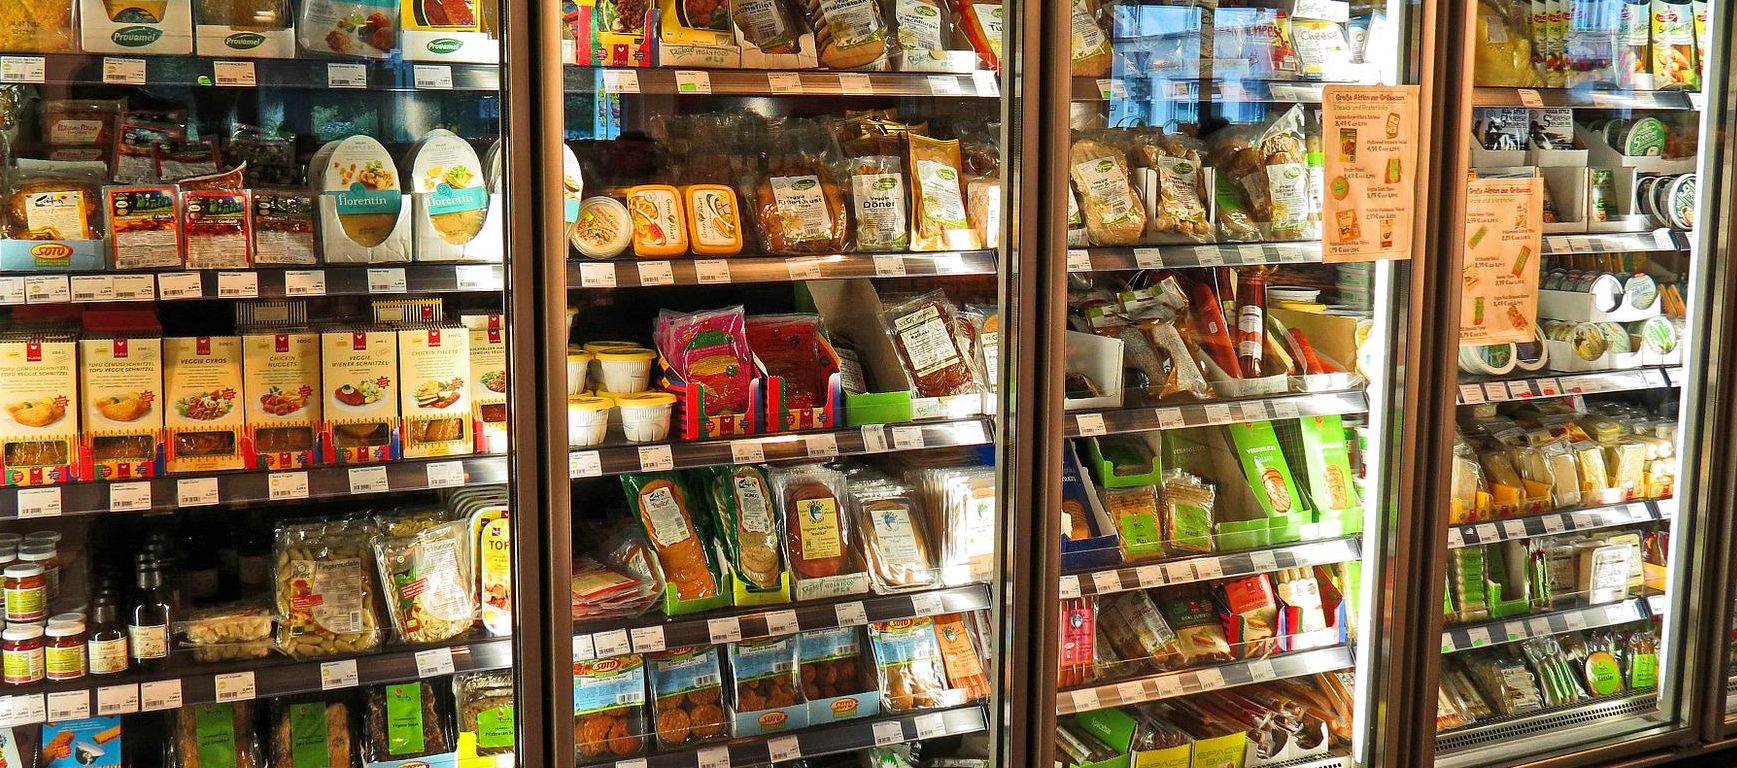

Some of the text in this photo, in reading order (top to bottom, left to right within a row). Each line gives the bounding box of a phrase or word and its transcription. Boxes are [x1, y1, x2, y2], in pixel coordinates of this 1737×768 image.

[113, 32, 157, 42] Provamel
[1301, 31, 1338, 41] Cheese
[226, 37, 261, 46] Provamel
[338, 193, 378, 206] florentin
[863, 201, 895, 209] Döner
[36, 247, 65, 257] SOTO
[488, 540, 510, 551] TOF
[596, 661, 615, 670] SOTO
